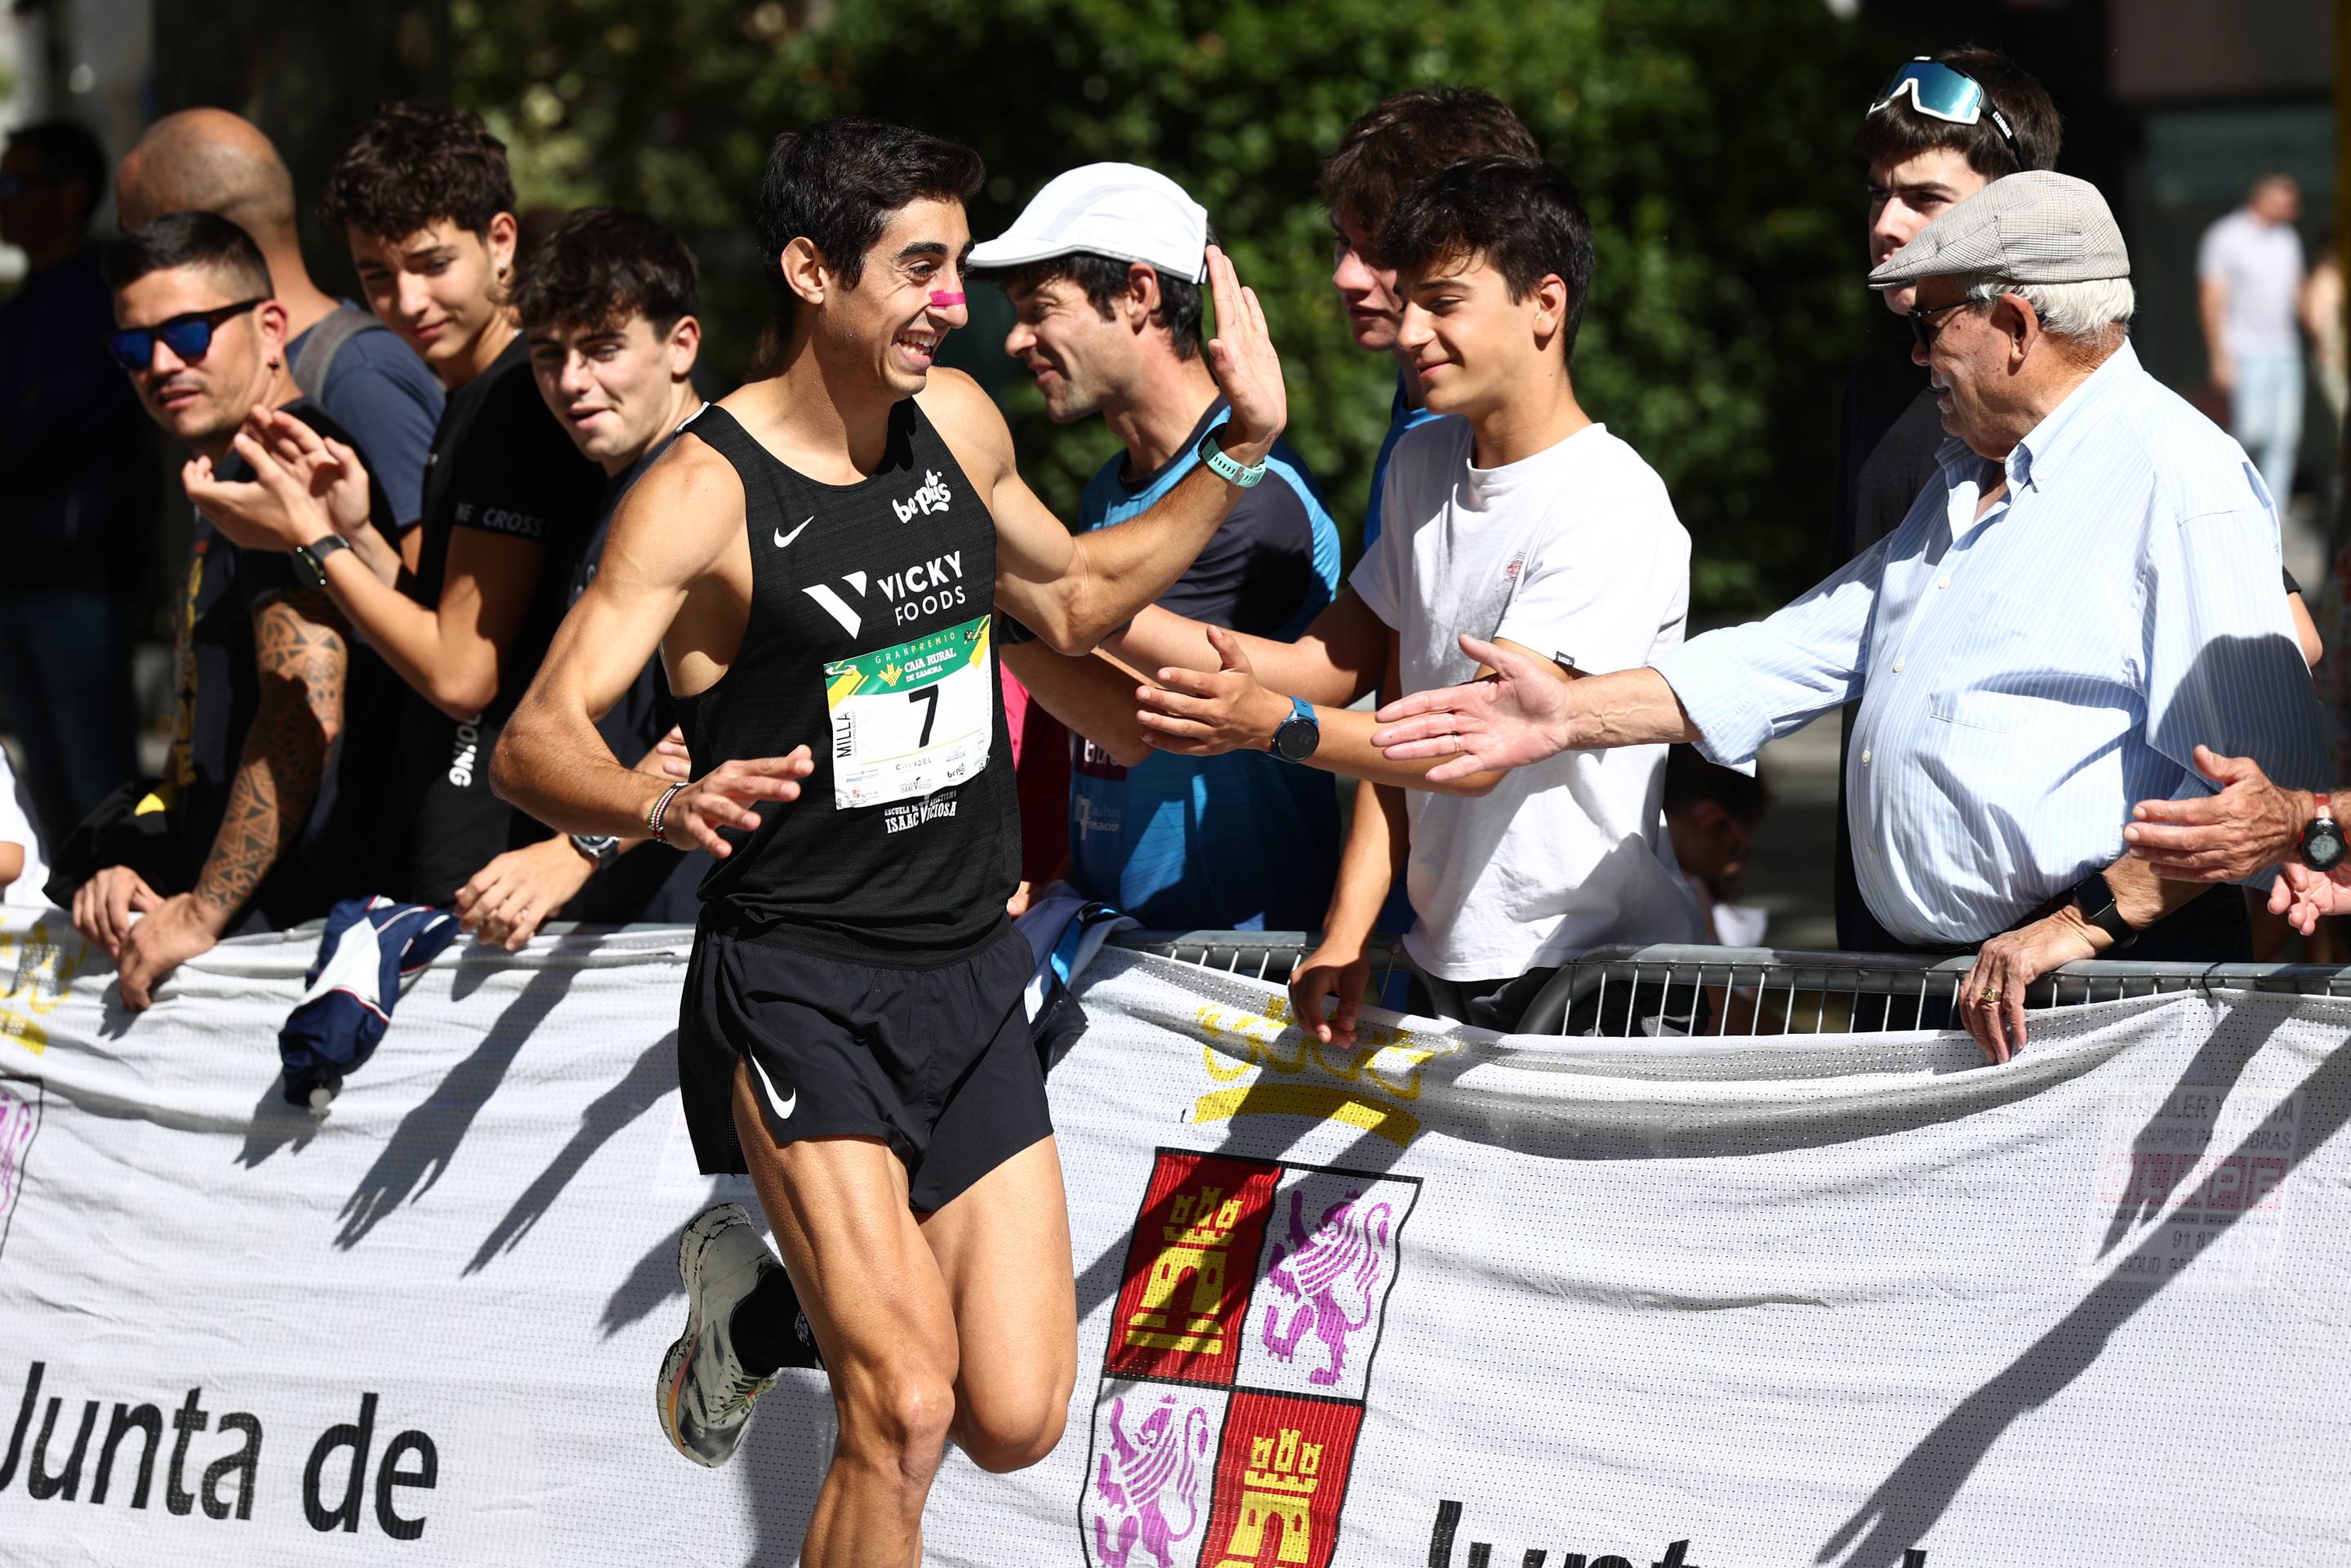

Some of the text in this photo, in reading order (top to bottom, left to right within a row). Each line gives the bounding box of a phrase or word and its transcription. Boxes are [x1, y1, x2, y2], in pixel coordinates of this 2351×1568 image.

[876, 550, 963, 603] VICKY
[894, 586, 966, 626] FOODS
[904, 647, 957, 673] CAJA RURAL
[906, 665, 942, 683] DE ZAMORA
[836, 712, 852, 758] MILLA
[909, 684, 939, 748] 7
[884, 805, 911, 816] ESCUELA
[0, 1361, 439, 1540] Junta de
